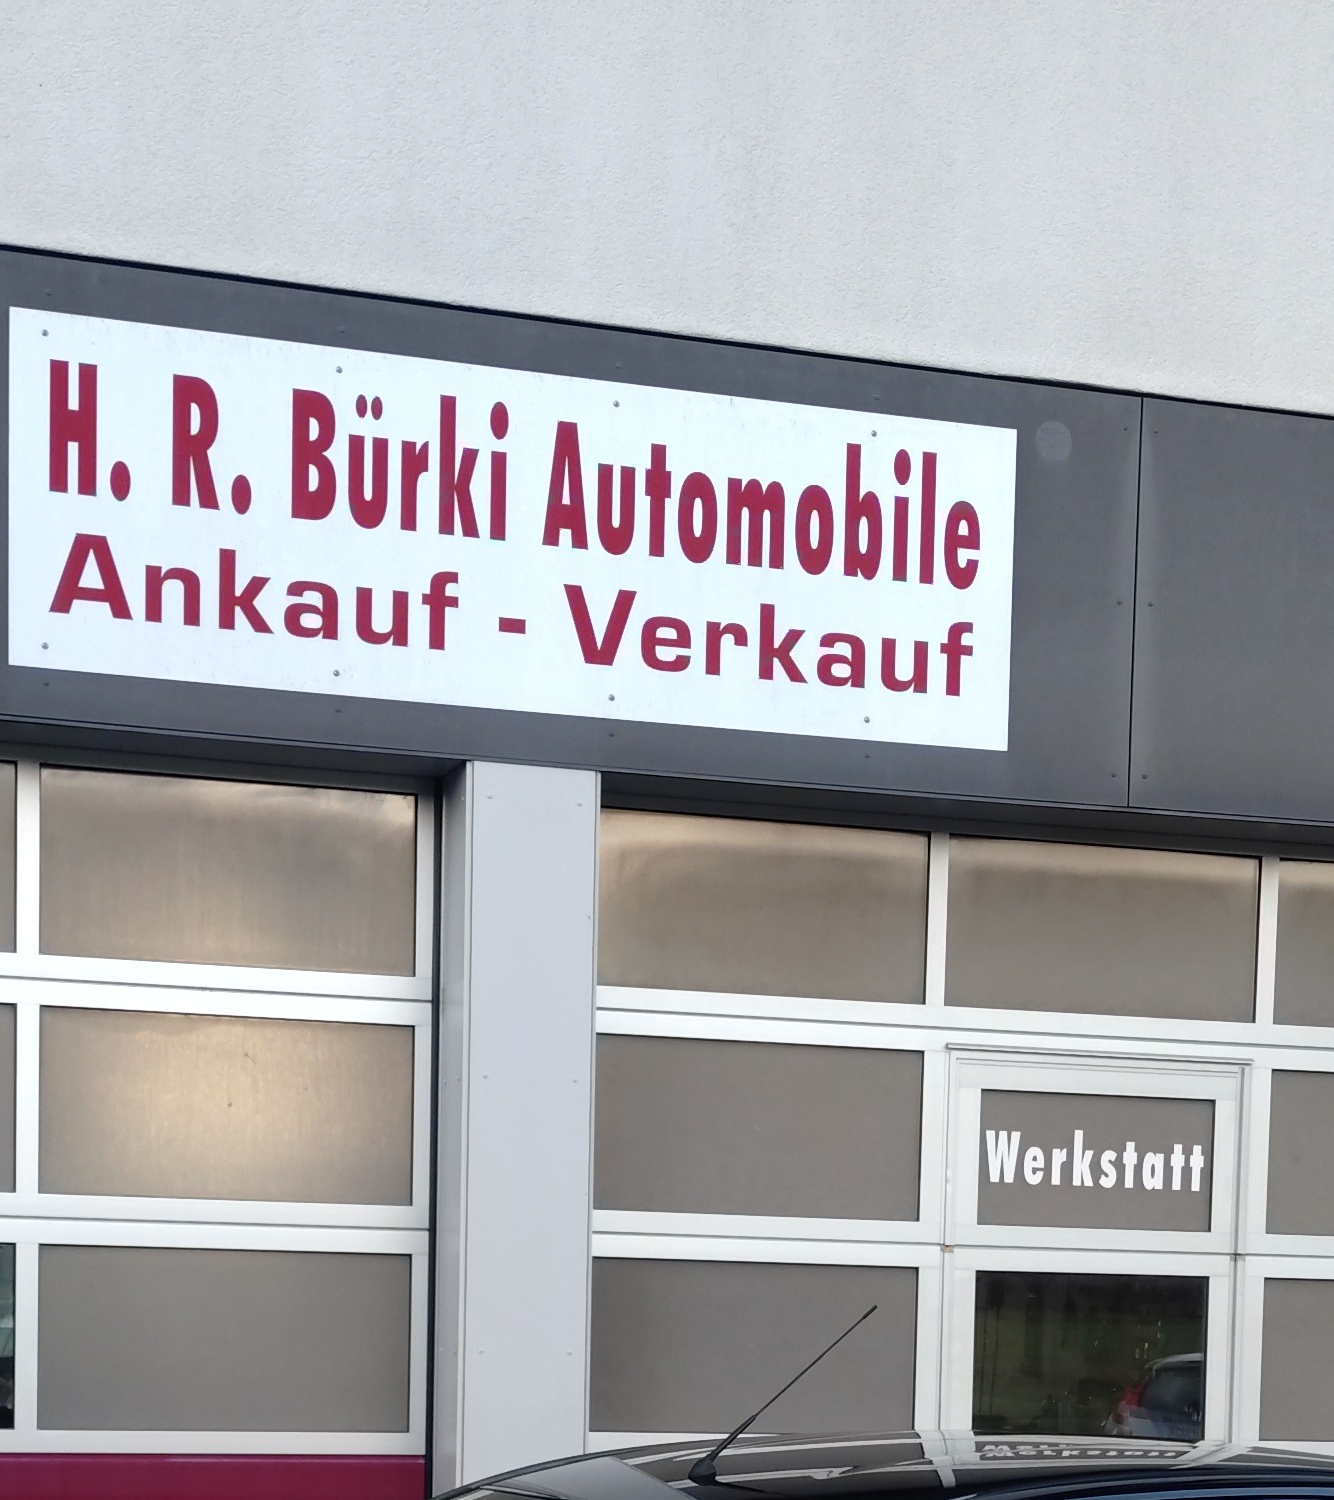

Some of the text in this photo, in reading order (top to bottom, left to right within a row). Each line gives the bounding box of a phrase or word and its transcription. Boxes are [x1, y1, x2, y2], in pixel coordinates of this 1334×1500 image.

[49, 359, 981, 590] H. R. Bürki Automobile
[49, 532, 974, 698] Ankauf - Verkauf
[985, 1129, 1204, 1192] Werkstatt
